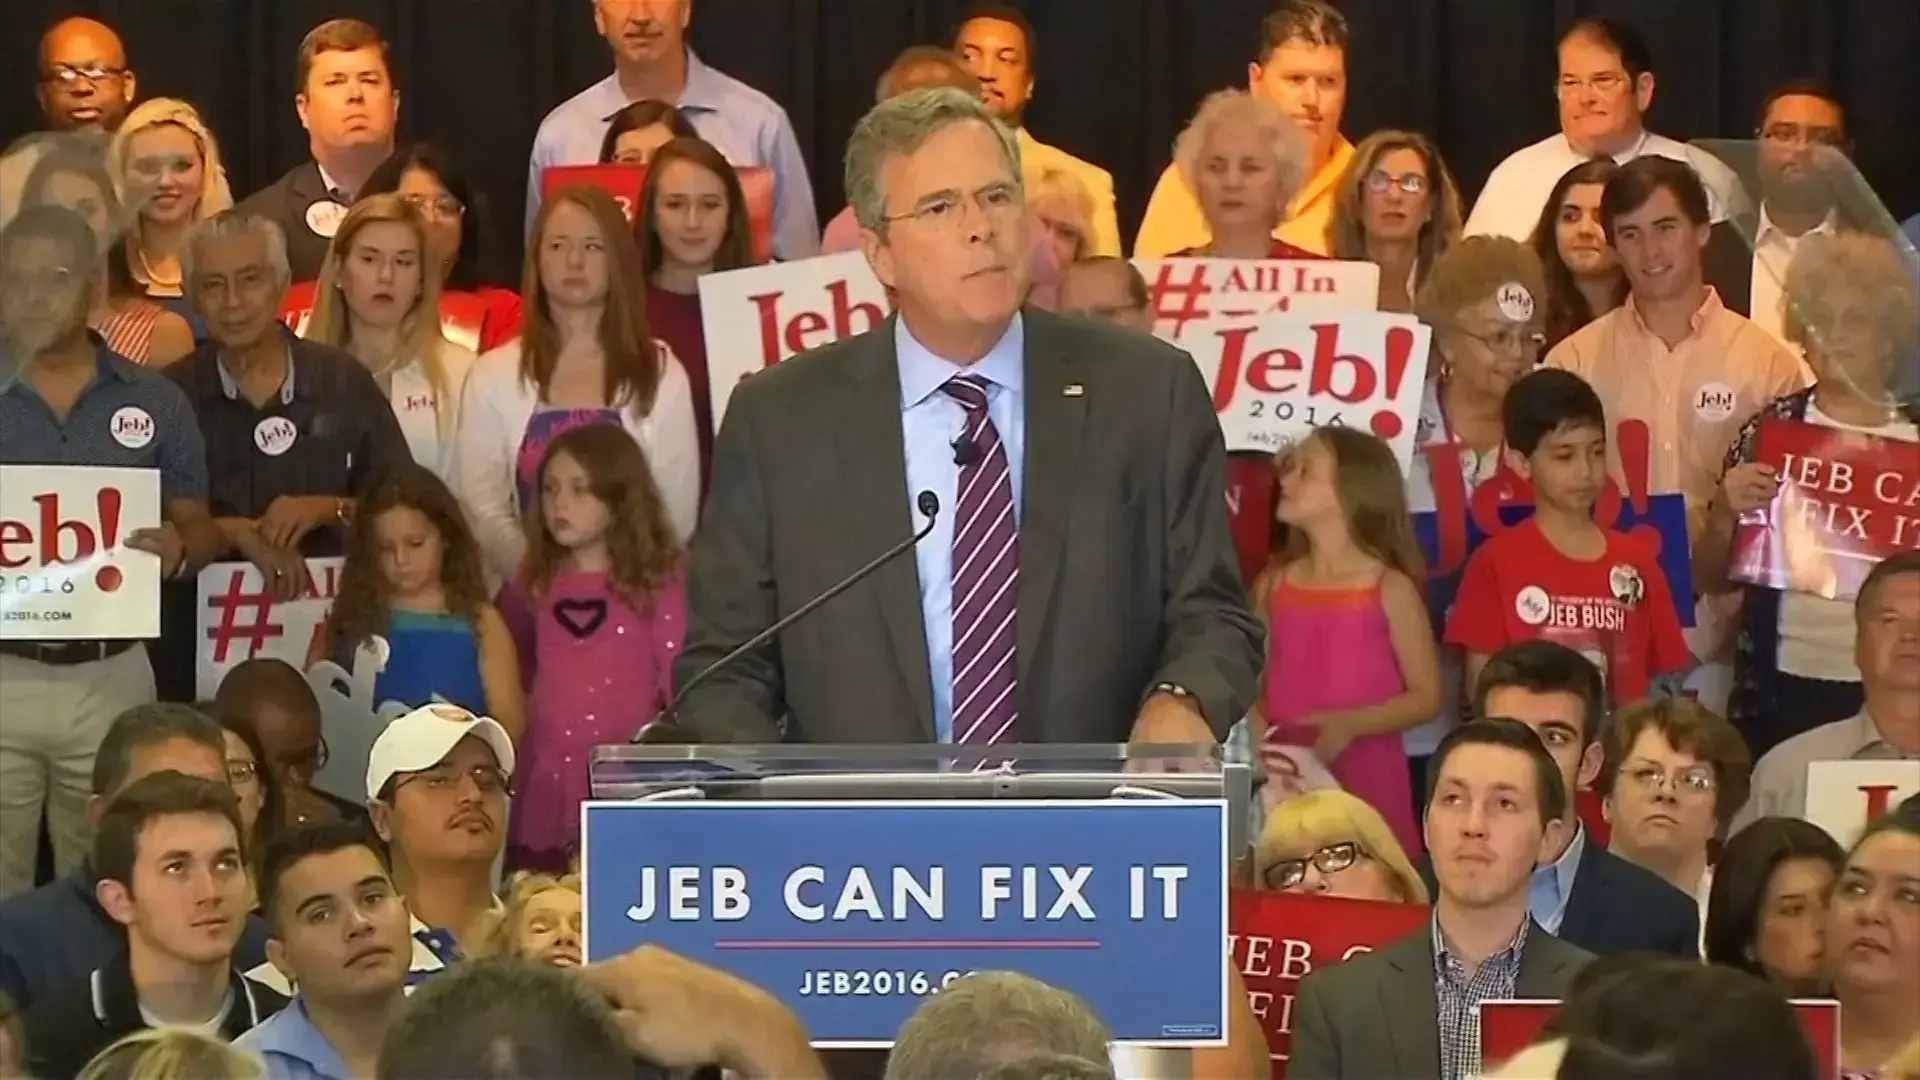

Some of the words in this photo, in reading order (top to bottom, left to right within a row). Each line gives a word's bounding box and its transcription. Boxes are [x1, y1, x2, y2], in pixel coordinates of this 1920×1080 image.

[1293, 267, 1337, 293] In
[1213, 323, 1415, 439] Jeb!
[1249, 400, 1344, 428] 2016
[1696, 391, 1733, 411] Jeb!
[113, 415, 150, 437] Jeb!
[260, 420, 294, 447] Jeb!
[1774, 453, 1854, 494] JEB
[1799, 498, 1873, 540] FIX
[1548, 603, 1578, 627] JEB
[1582, 605, 1625, 632] BUSH
[626, 866, 751, 920] JEB
[783, 866, 944, 920] CAN
[981, 867, 1097, 919] FIX
[1130, 867, 1189, 919] IT
[799, 971, 978, 995] JEB2016.C
